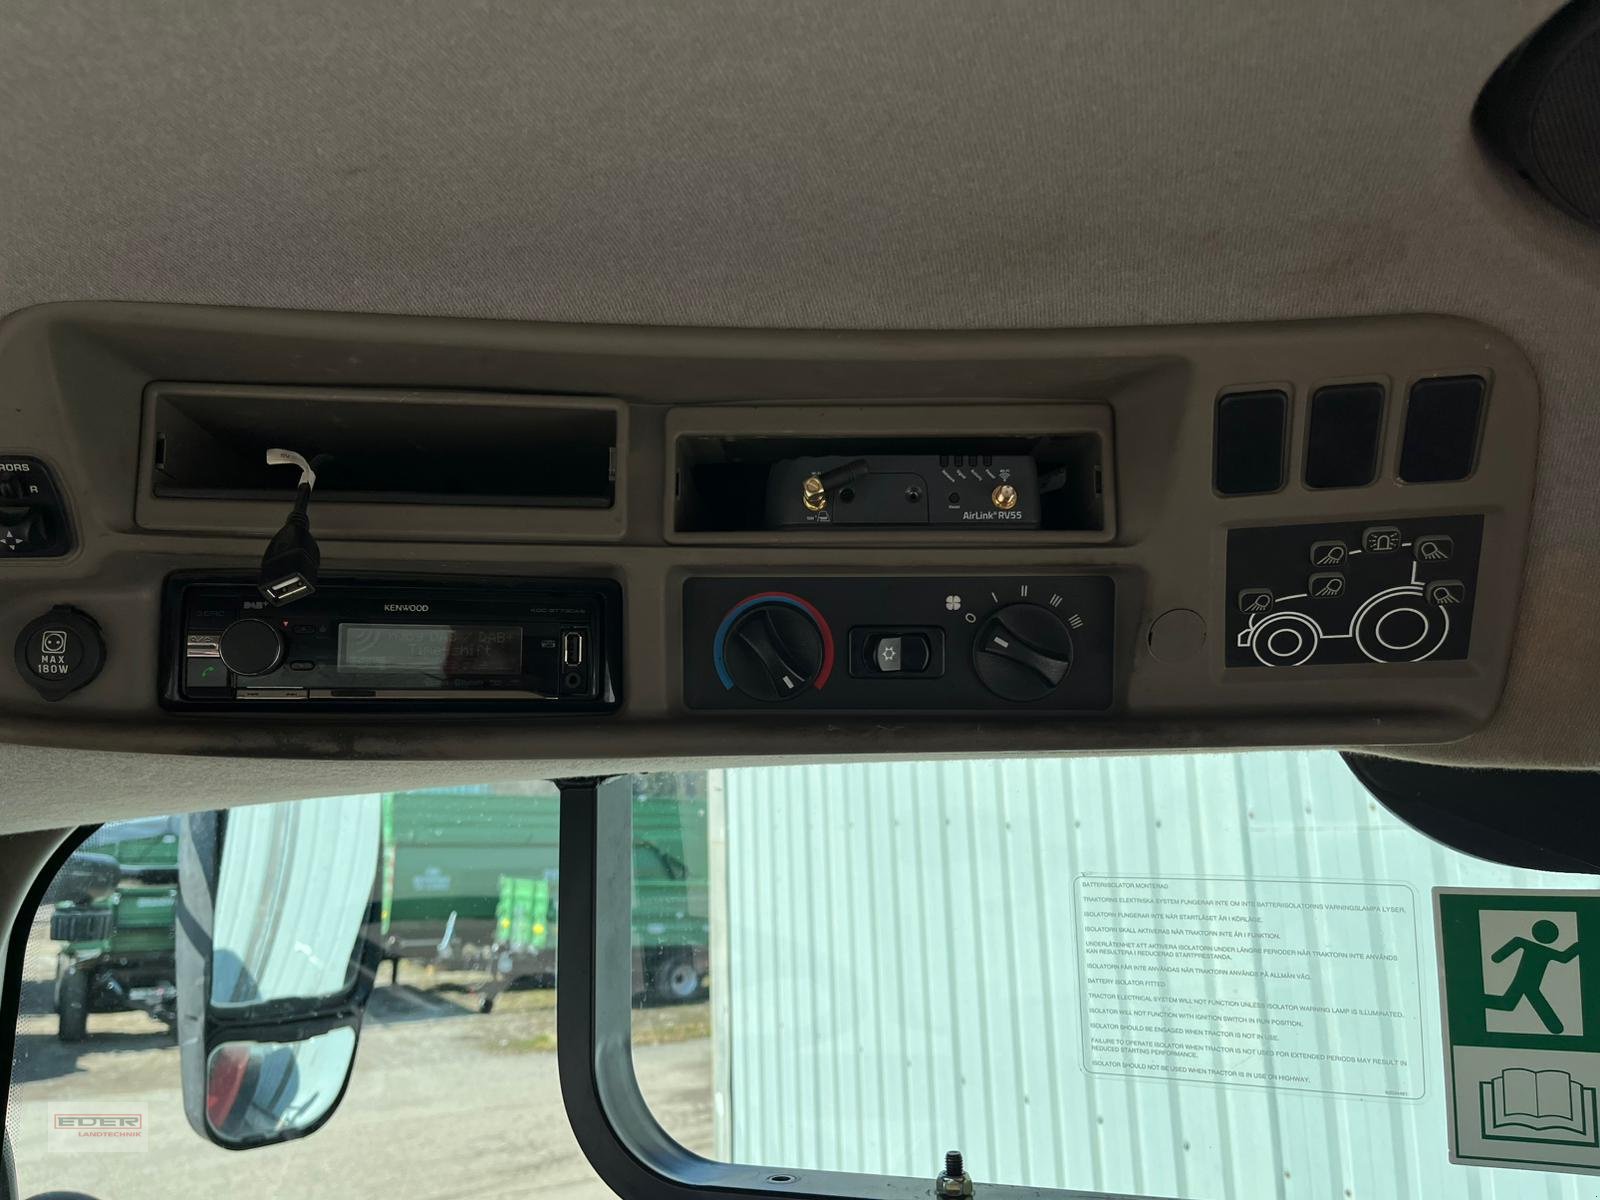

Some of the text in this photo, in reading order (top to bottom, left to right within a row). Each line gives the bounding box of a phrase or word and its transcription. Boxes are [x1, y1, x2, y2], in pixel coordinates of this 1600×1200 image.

[29, 484, 39, 493] R
[383, 603, 430, 612] KENWOOD
[41, 655, 65, 664] MAX
[38, 664, 69, 674] 180W
